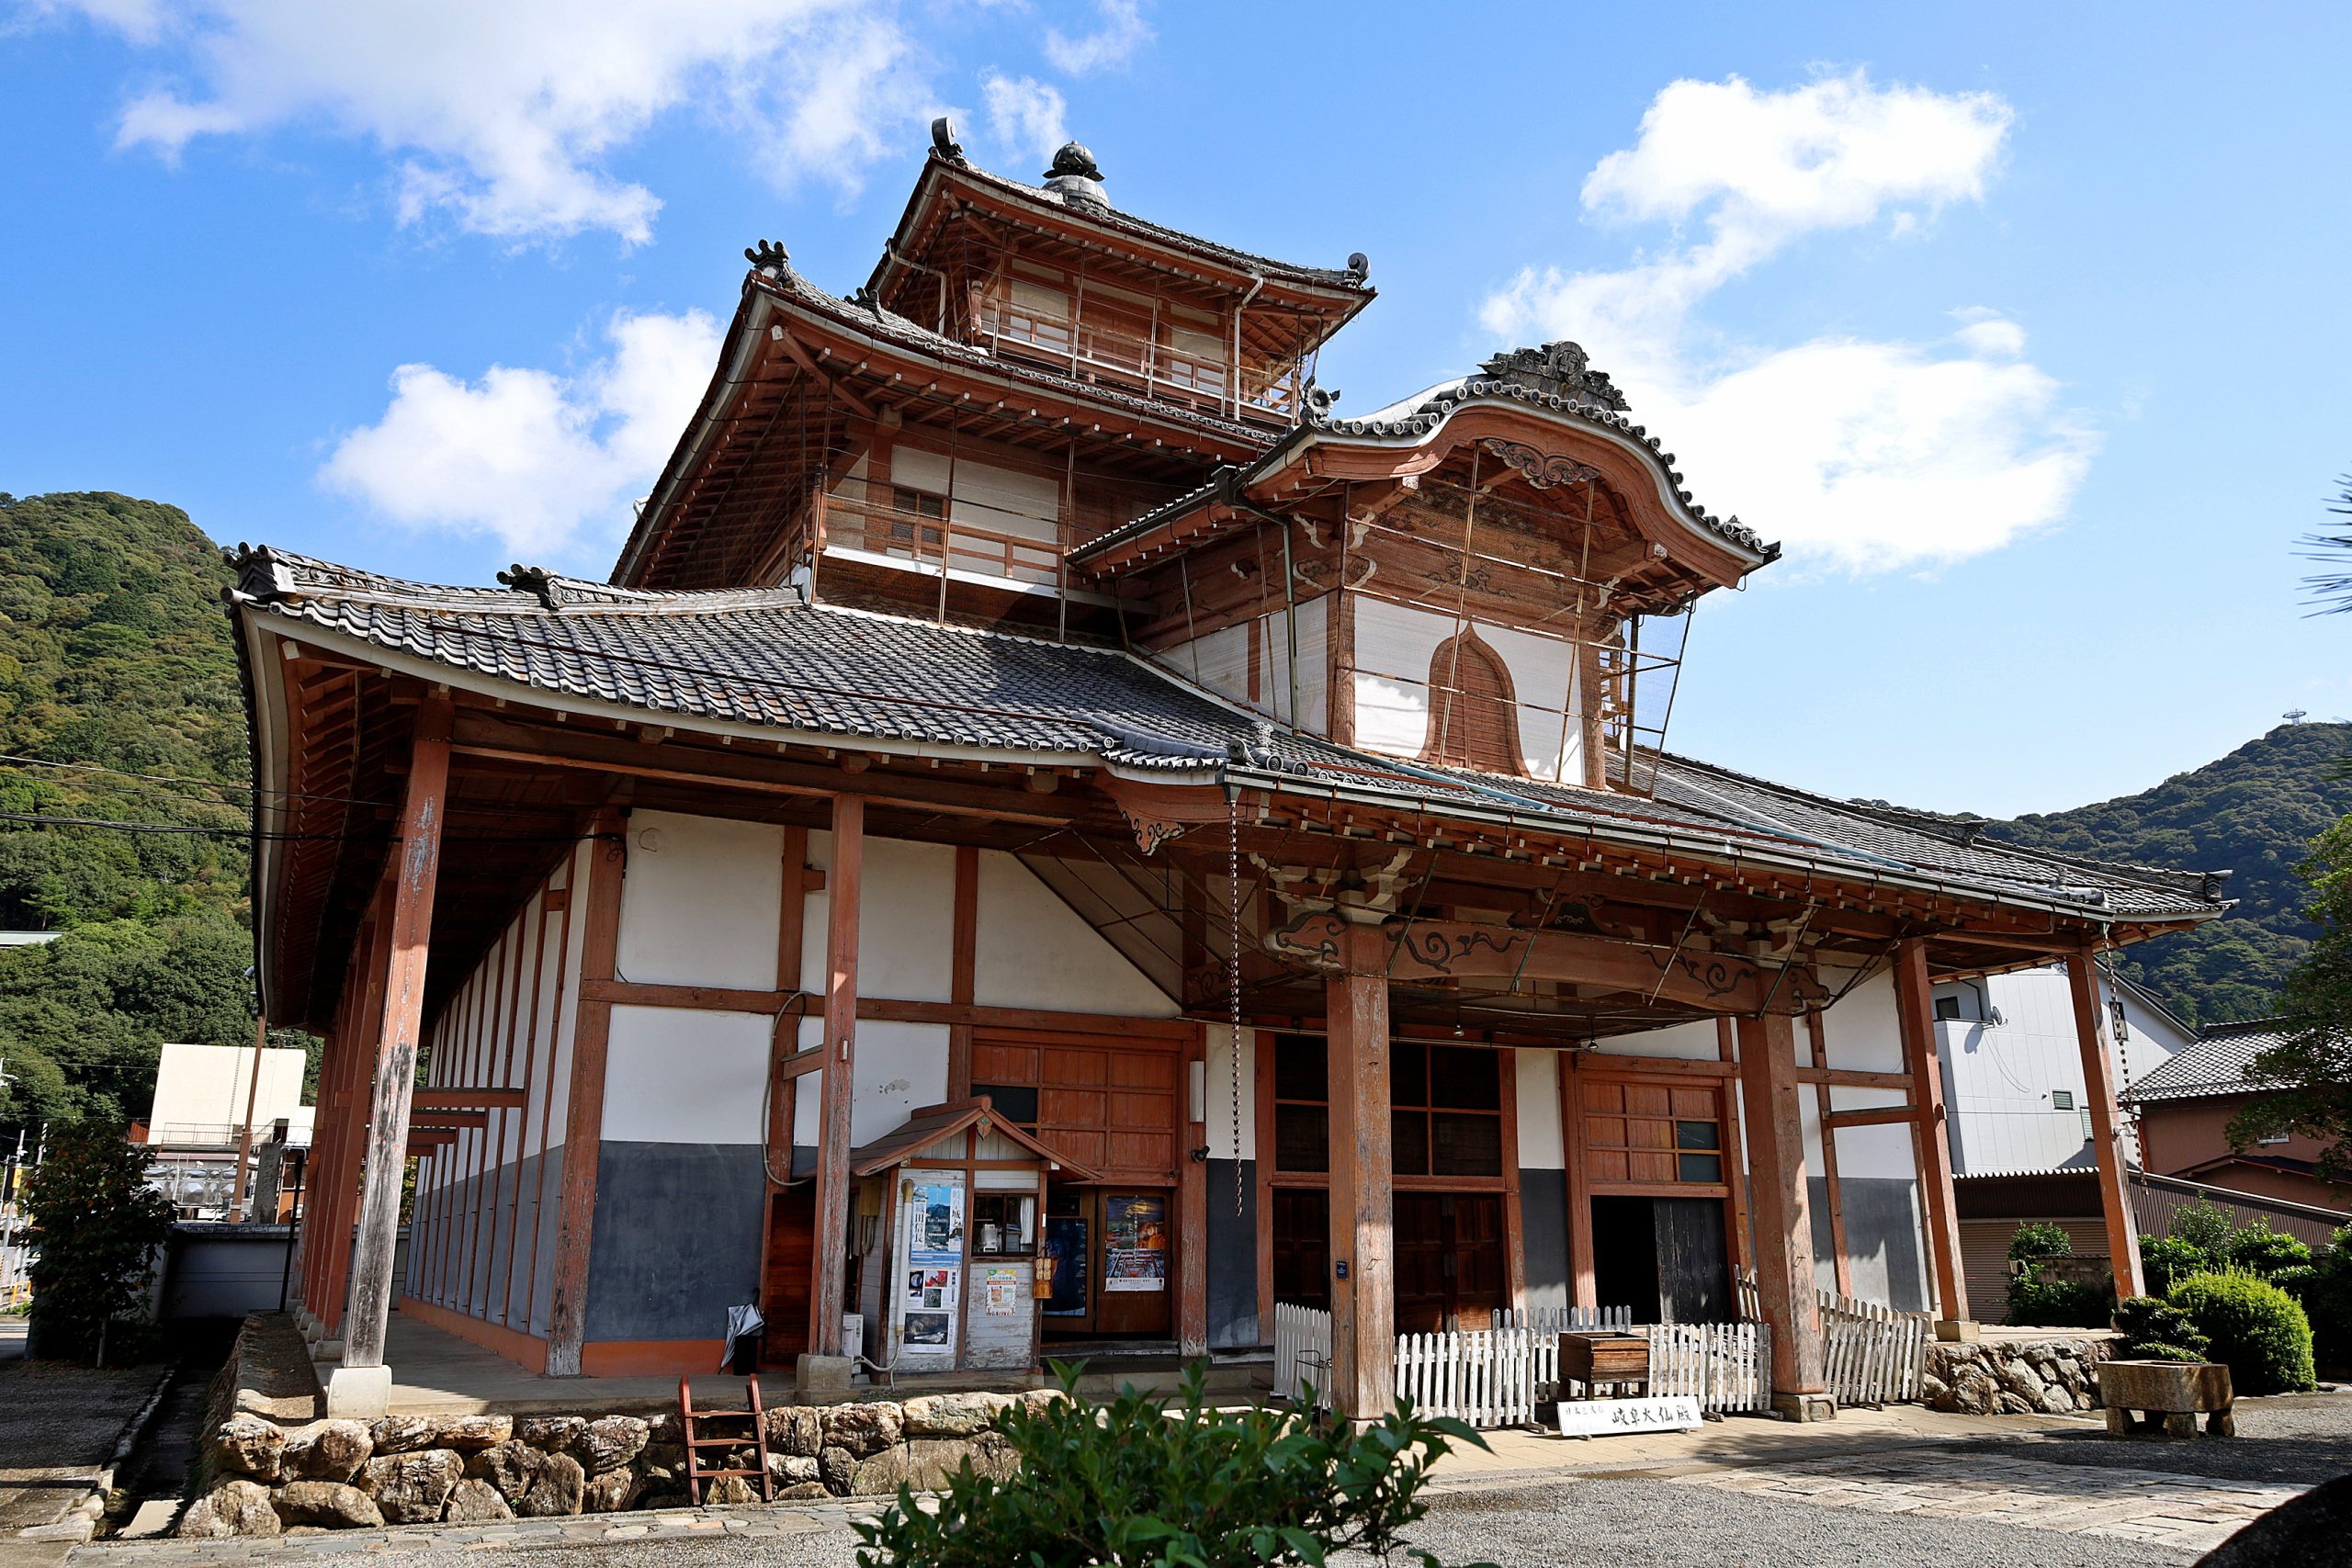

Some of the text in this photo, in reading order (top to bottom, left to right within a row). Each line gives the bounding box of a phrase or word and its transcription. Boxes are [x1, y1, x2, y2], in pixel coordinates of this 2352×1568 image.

[1611, 1404, 1692, 1427] 岐阜大仏殿
